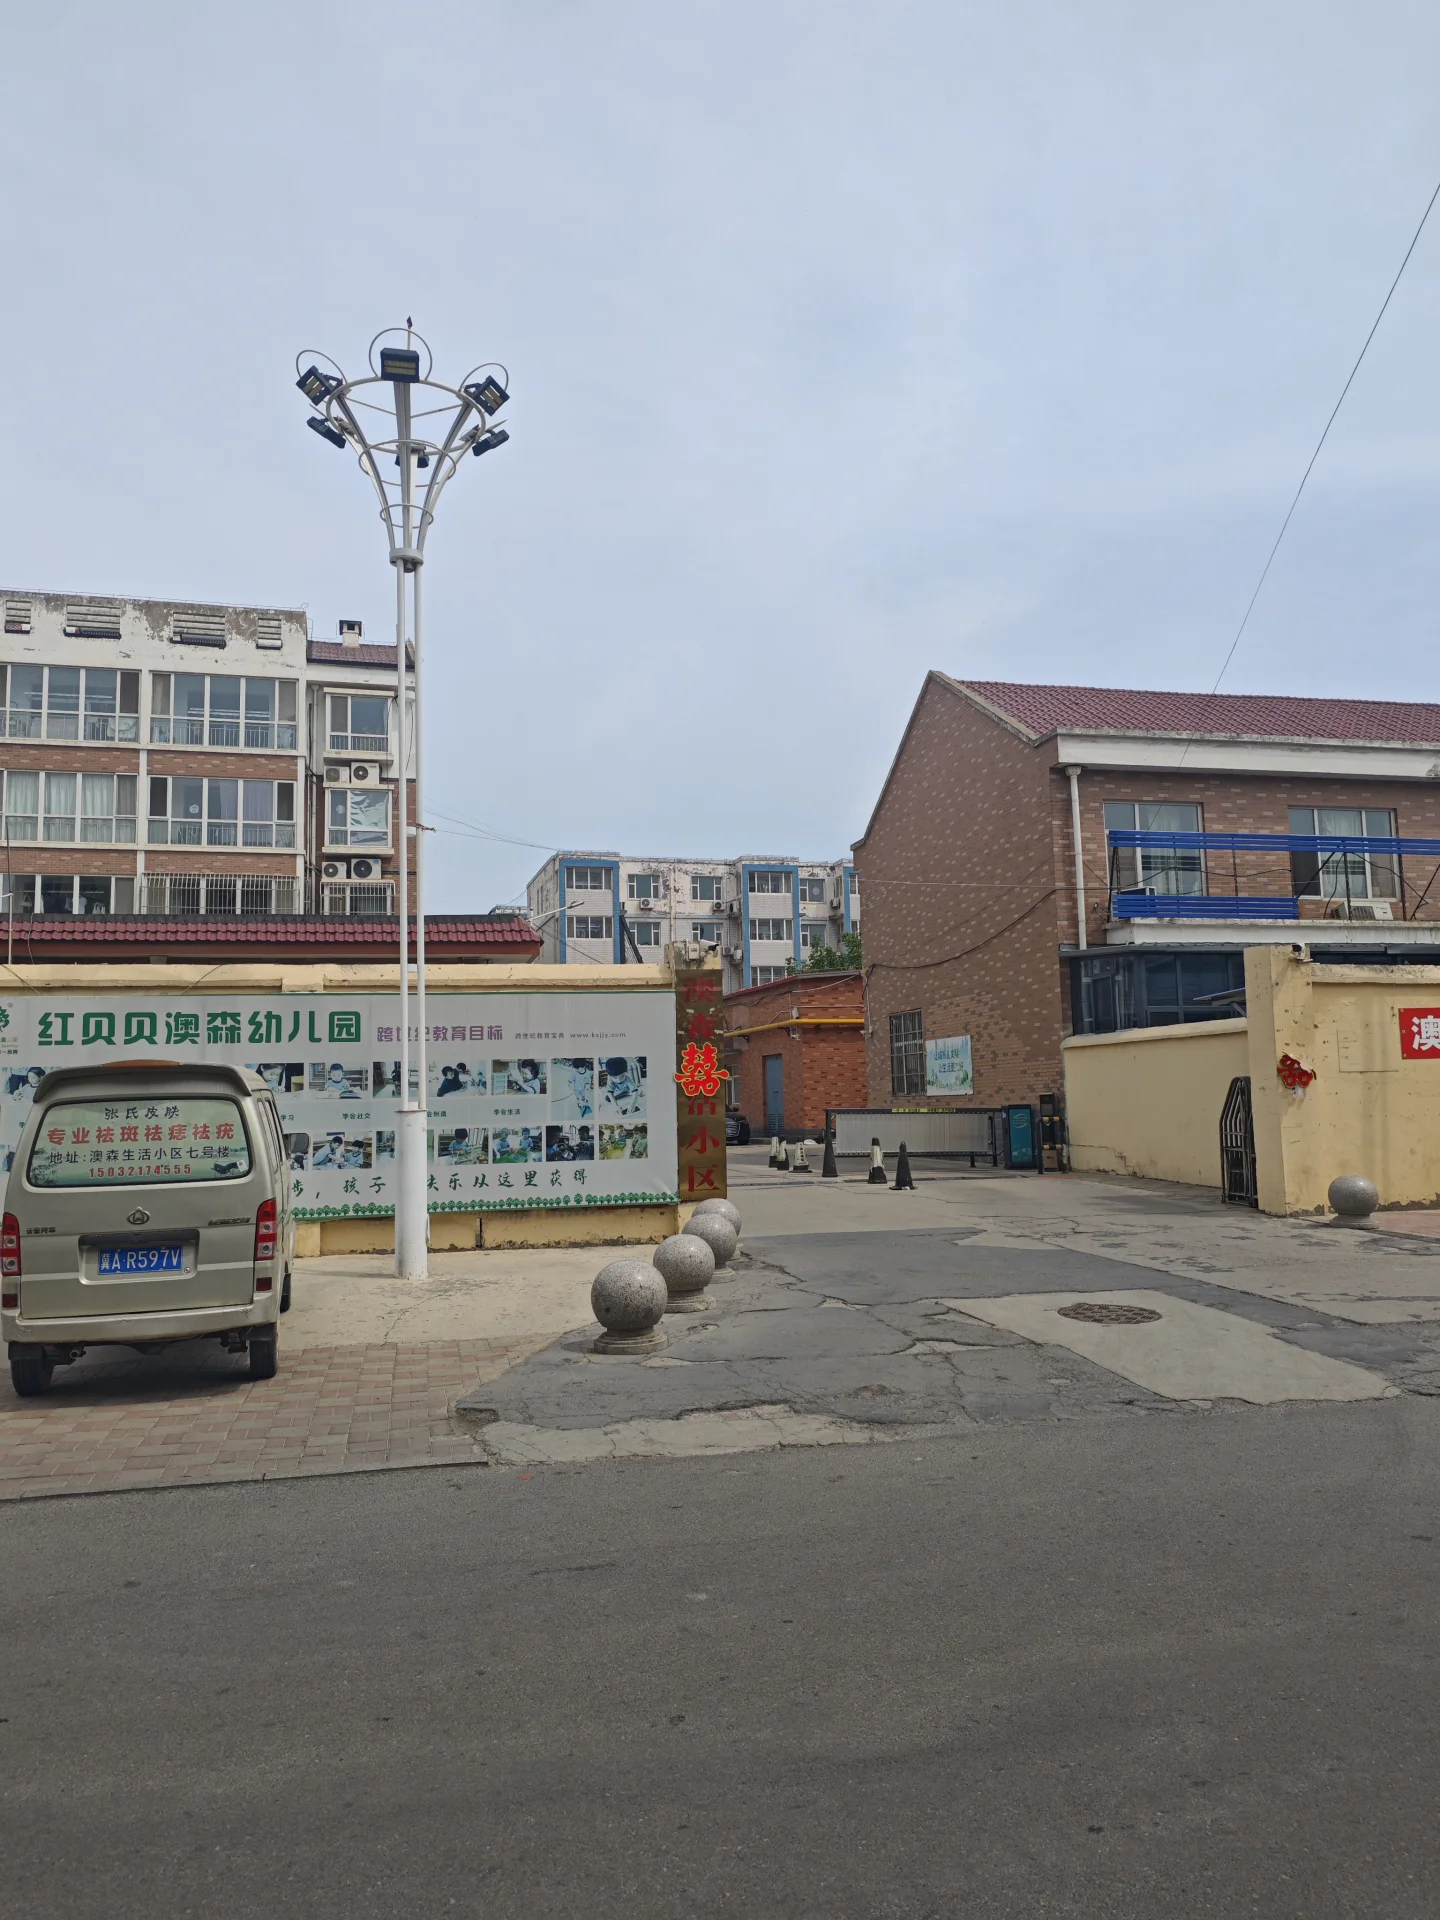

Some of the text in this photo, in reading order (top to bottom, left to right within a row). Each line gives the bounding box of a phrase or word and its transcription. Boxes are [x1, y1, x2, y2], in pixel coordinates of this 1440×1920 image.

[37, 1010, 361, 1046] 红贝贝澳森幼儿园
[104, 1105, 180, 1120] 张氏皮肤
[493, 1108, 521, 1116] 学会生活
[47, 1122, 235, 1146] 专业祛斑祛痣祛疣
[89, 1164, 192, 1179] 15032174555
